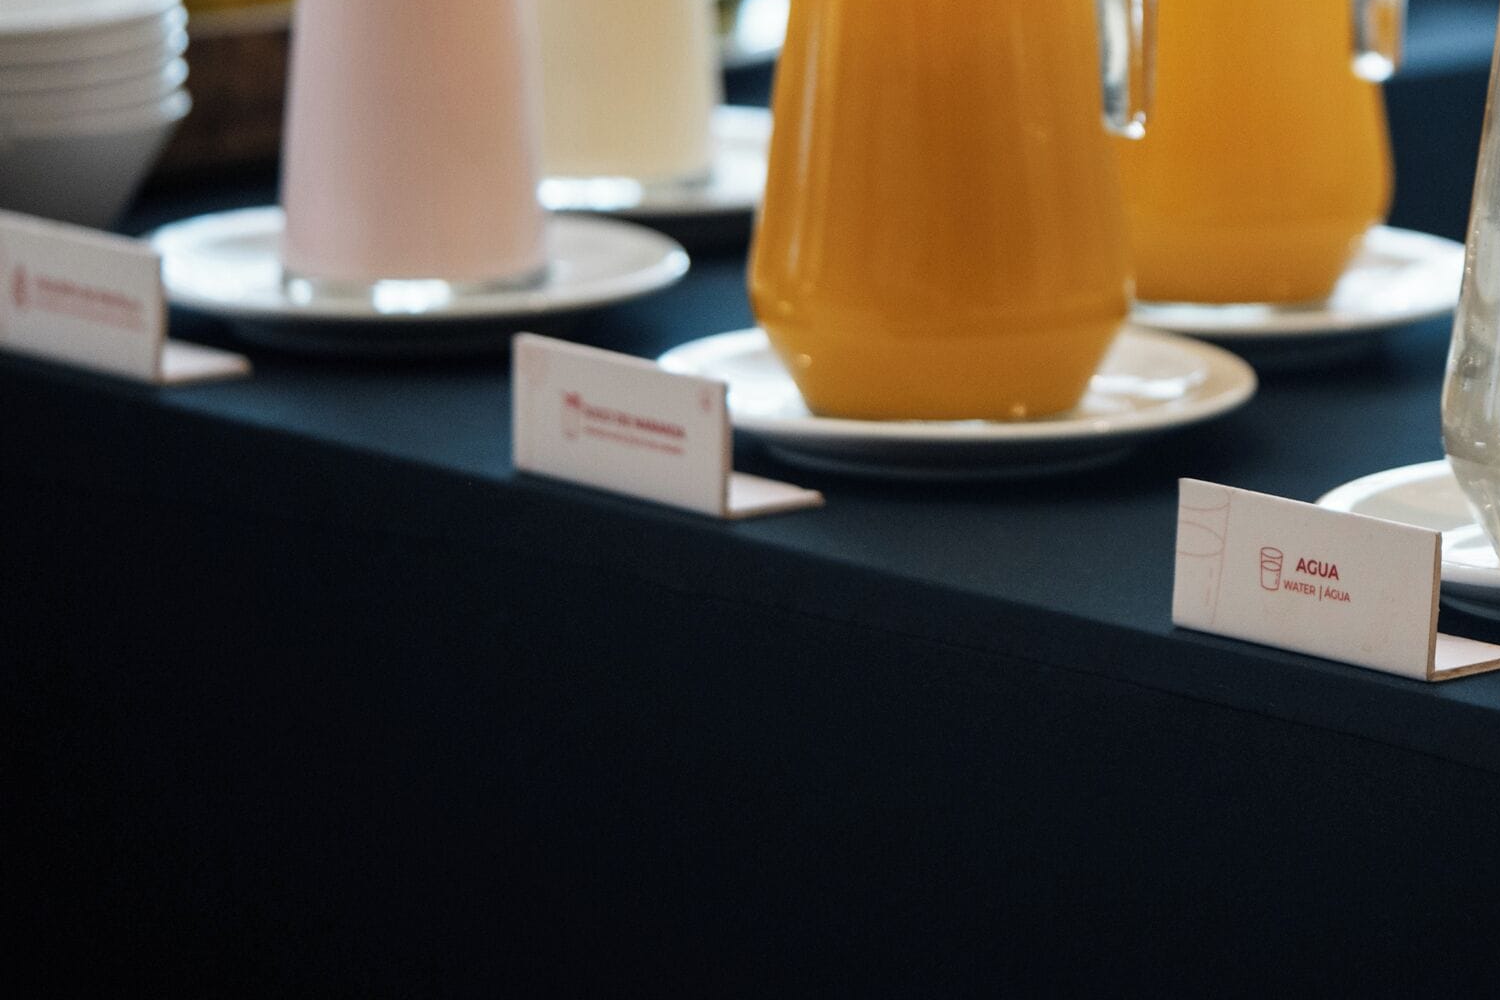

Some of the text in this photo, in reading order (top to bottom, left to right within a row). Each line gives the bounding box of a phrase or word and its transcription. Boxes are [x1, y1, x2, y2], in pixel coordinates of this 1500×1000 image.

[1296, 558, 1339, 580] AGUA
[1284, 580, 1316, 595] WATER
[1324, 586, 1351, 602] ÁGUA
